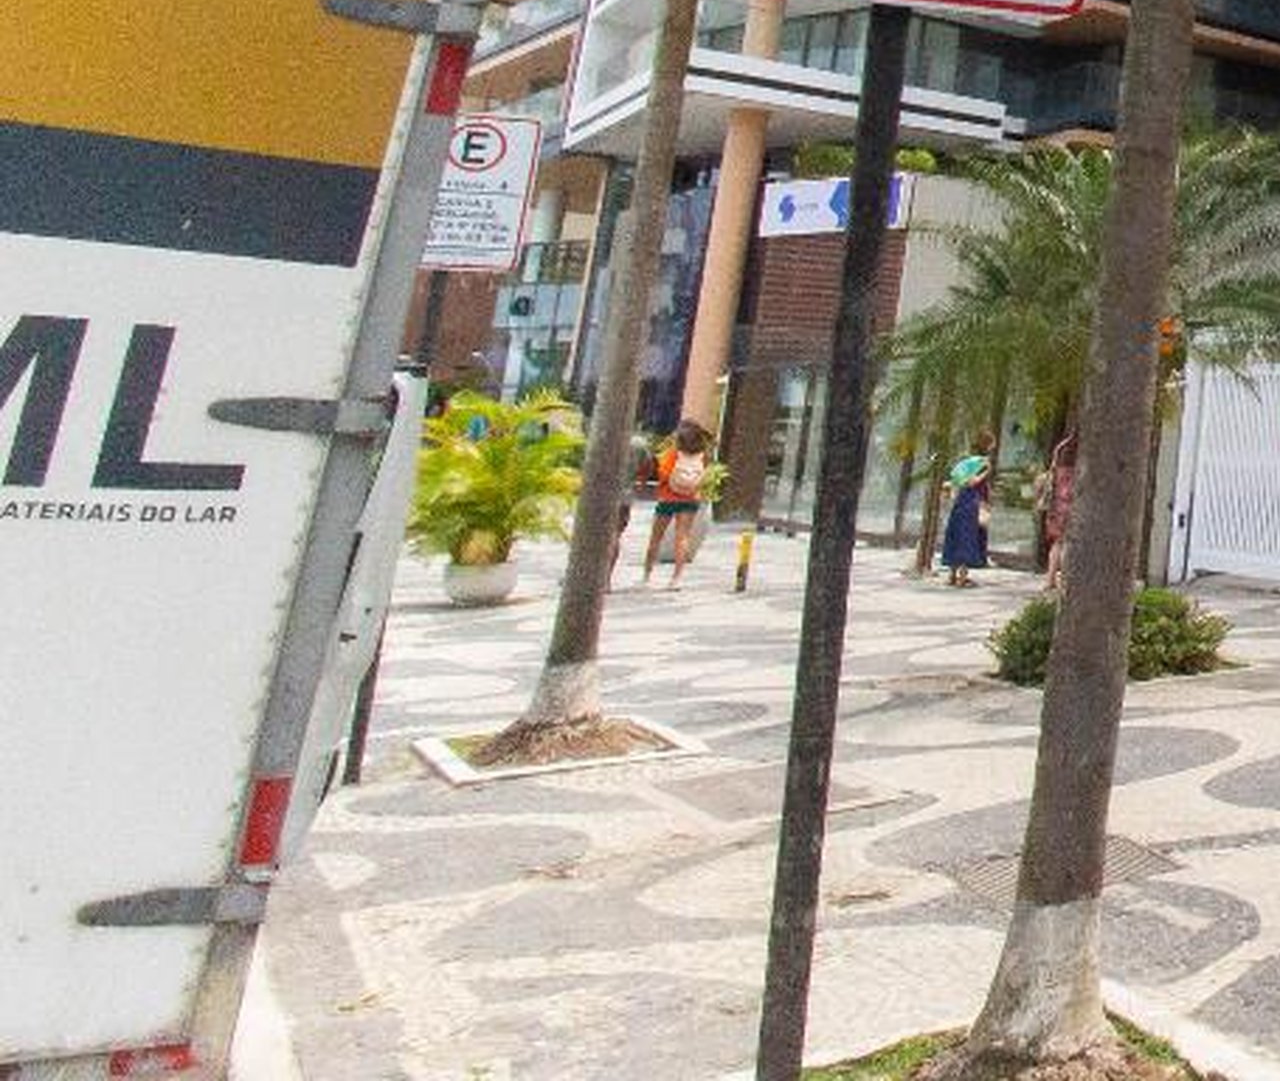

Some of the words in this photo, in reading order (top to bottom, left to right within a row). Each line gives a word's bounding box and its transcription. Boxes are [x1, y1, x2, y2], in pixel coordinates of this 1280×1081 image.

[461, 131, 490, 164] E
[140, 505, 176, 523] DO
[185, 505, 237, 524] LAR
